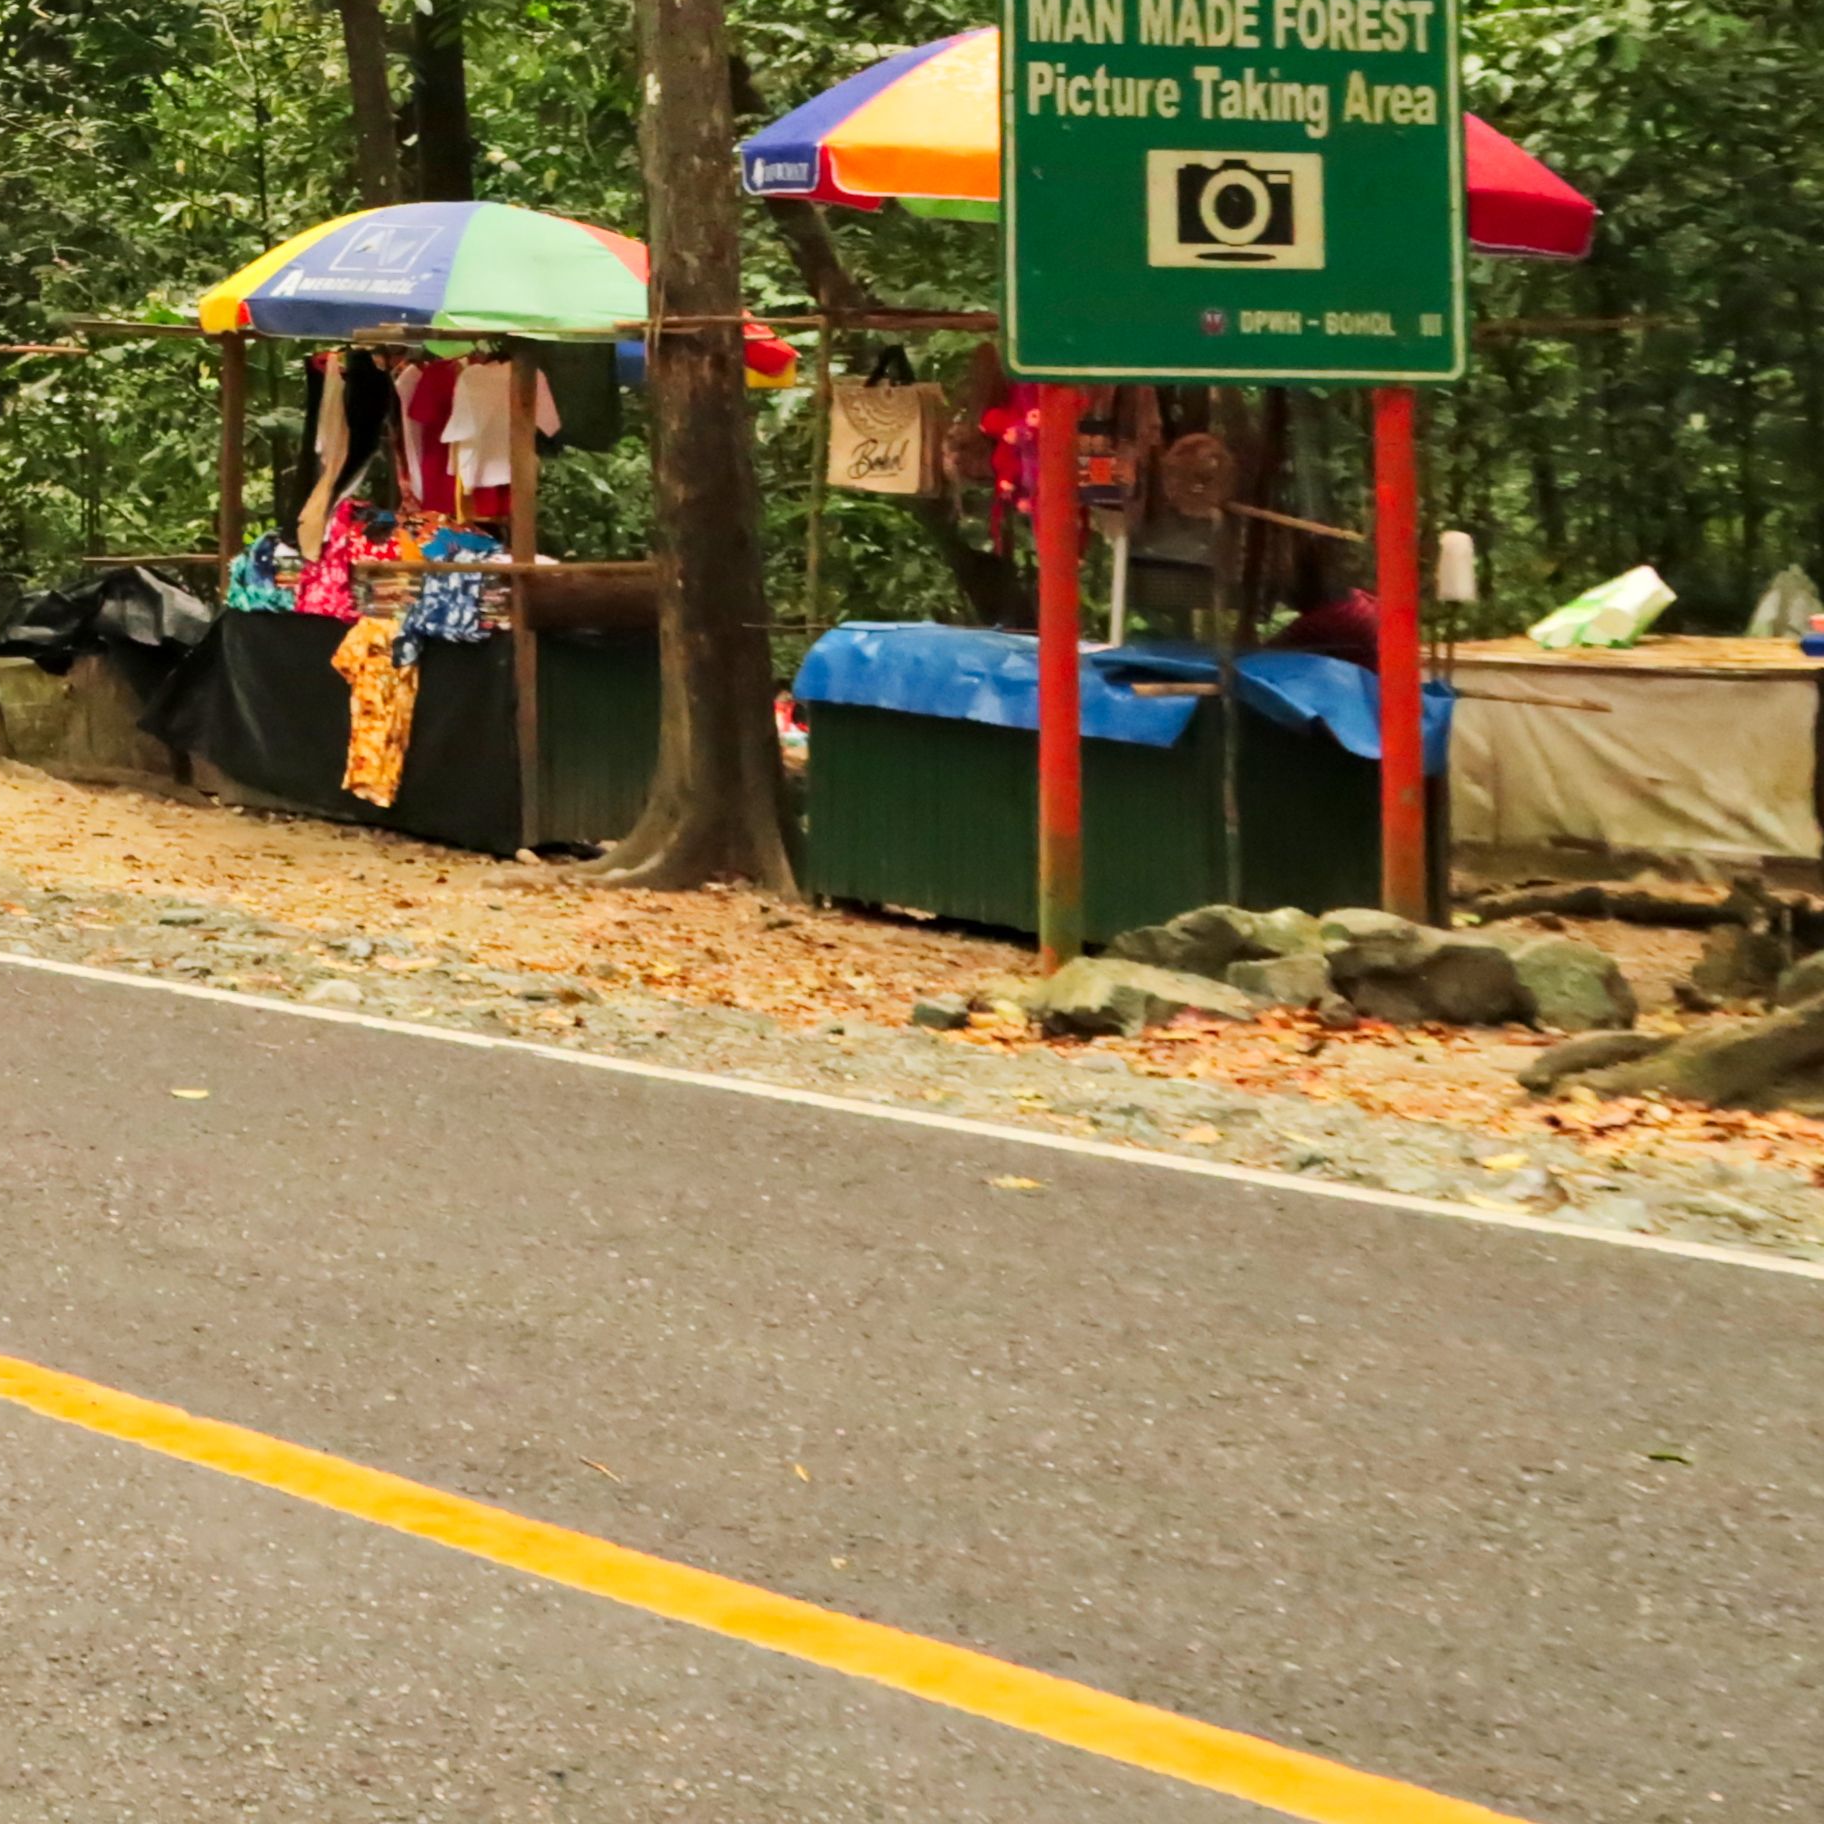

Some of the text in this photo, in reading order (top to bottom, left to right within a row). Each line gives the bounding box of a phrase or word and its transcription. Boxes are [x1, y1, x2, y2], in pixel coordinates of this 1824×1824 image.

[1027, 61, 1437, 139] Picture Taking Area
